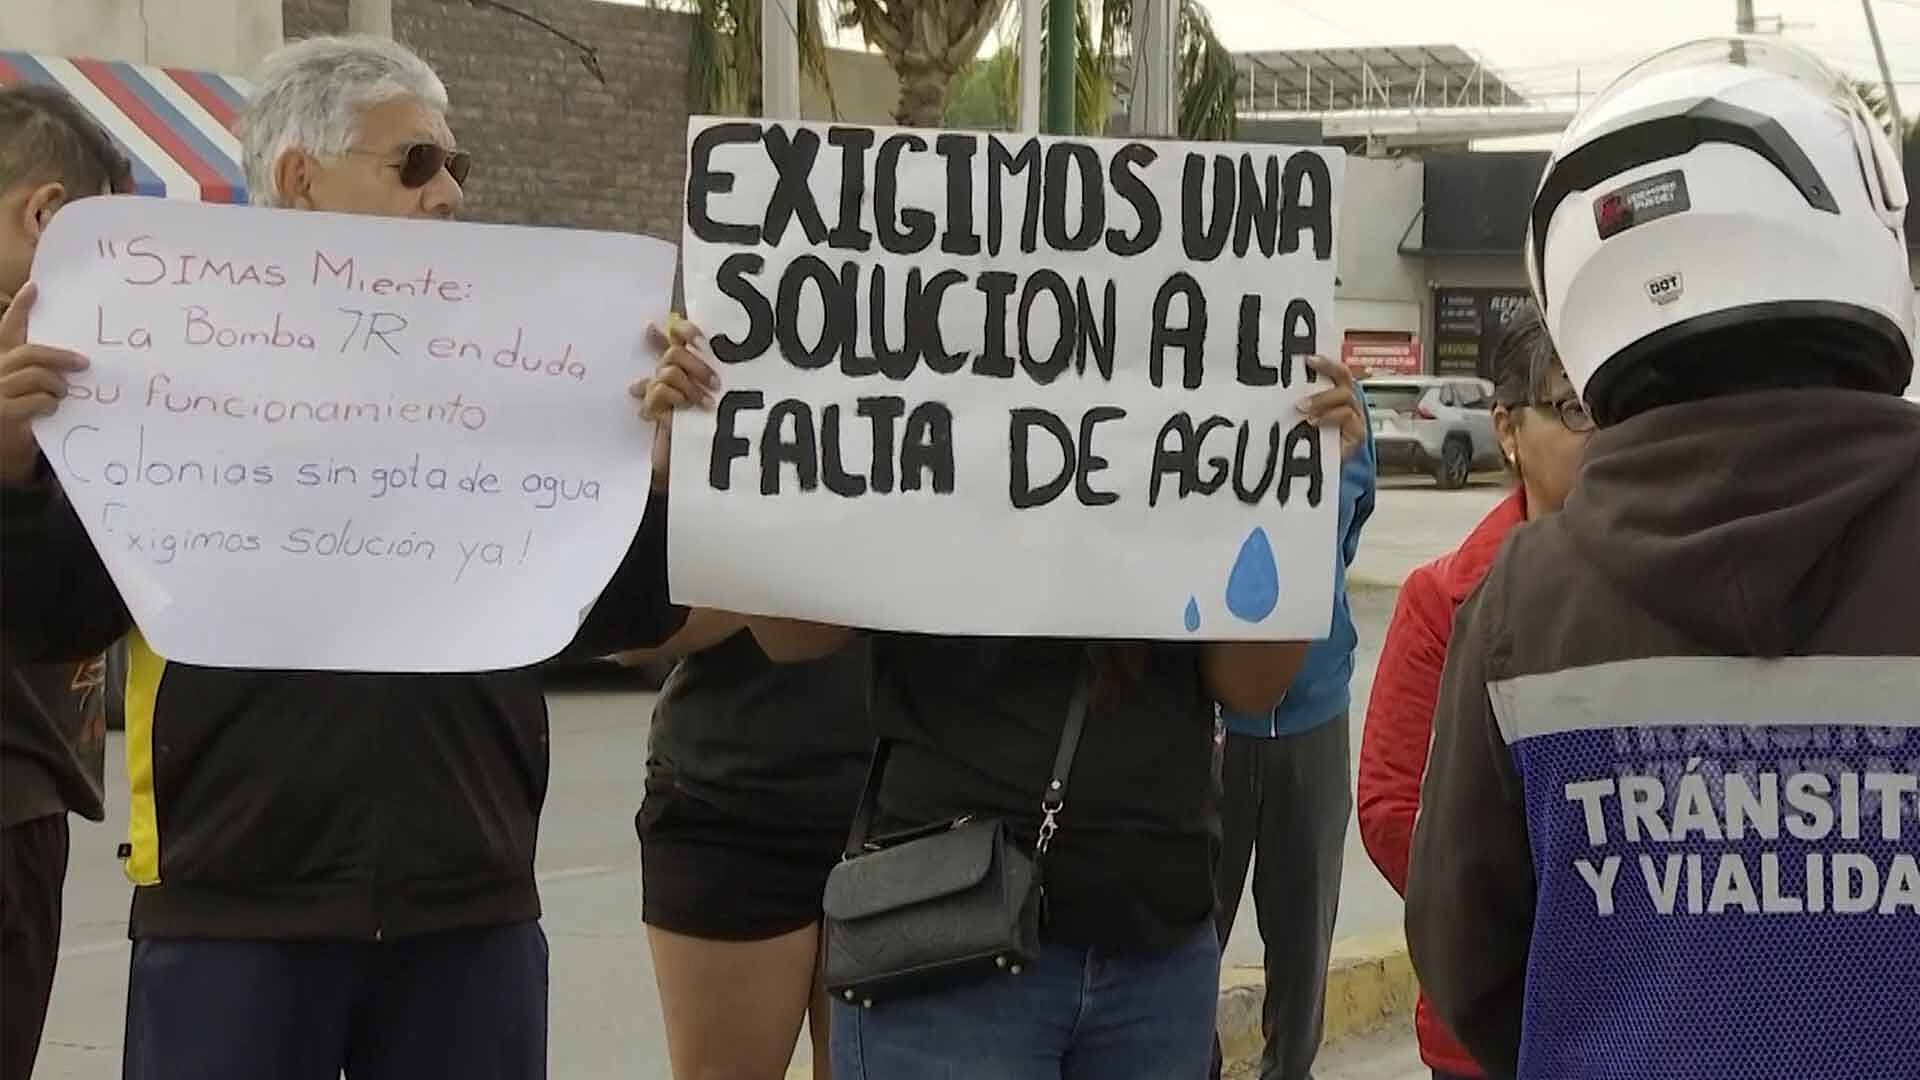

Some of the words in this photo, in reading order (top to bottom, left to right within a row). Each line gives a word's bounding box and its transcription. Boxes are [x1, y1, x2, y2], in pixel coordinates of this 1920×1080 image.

[687, 123, 1162, 257] EXIGIMOS
[1181, 150, 1332, 261] UNA
[313, 249, 473, 302] Miente:
[1650, 276, 1677, 295] DOT
[96, 304, 152, 349] La
[181, 304, 315, 349] Bomba
[338, 306, 409, 355] 7R
[427, 336, 482, 360] en
[493, 327, 587, 381] duda
[710, 253, 1116, 385] SOLUCION
[1149, 271, 1208, 389] A
[1236, 293, 1317, 389] LA
[146, 373, 487, 431] funcionamiento
[63, 424, 274, 486] Colonias
[296, 457, 357, 487] sin
[371, 453, 448, 499] gota
[459, 461, 502, 494] de
[522, 472, 602, 510] agua
[709, 391, 955, 496] FALTA
[1009, 406, 1127, 508] DE
[1149, 411, 1324, 509] AGUA
[1565, 757, 1920, 847] TRÁNSIT
[1573, 856, 1622, 916] Y
